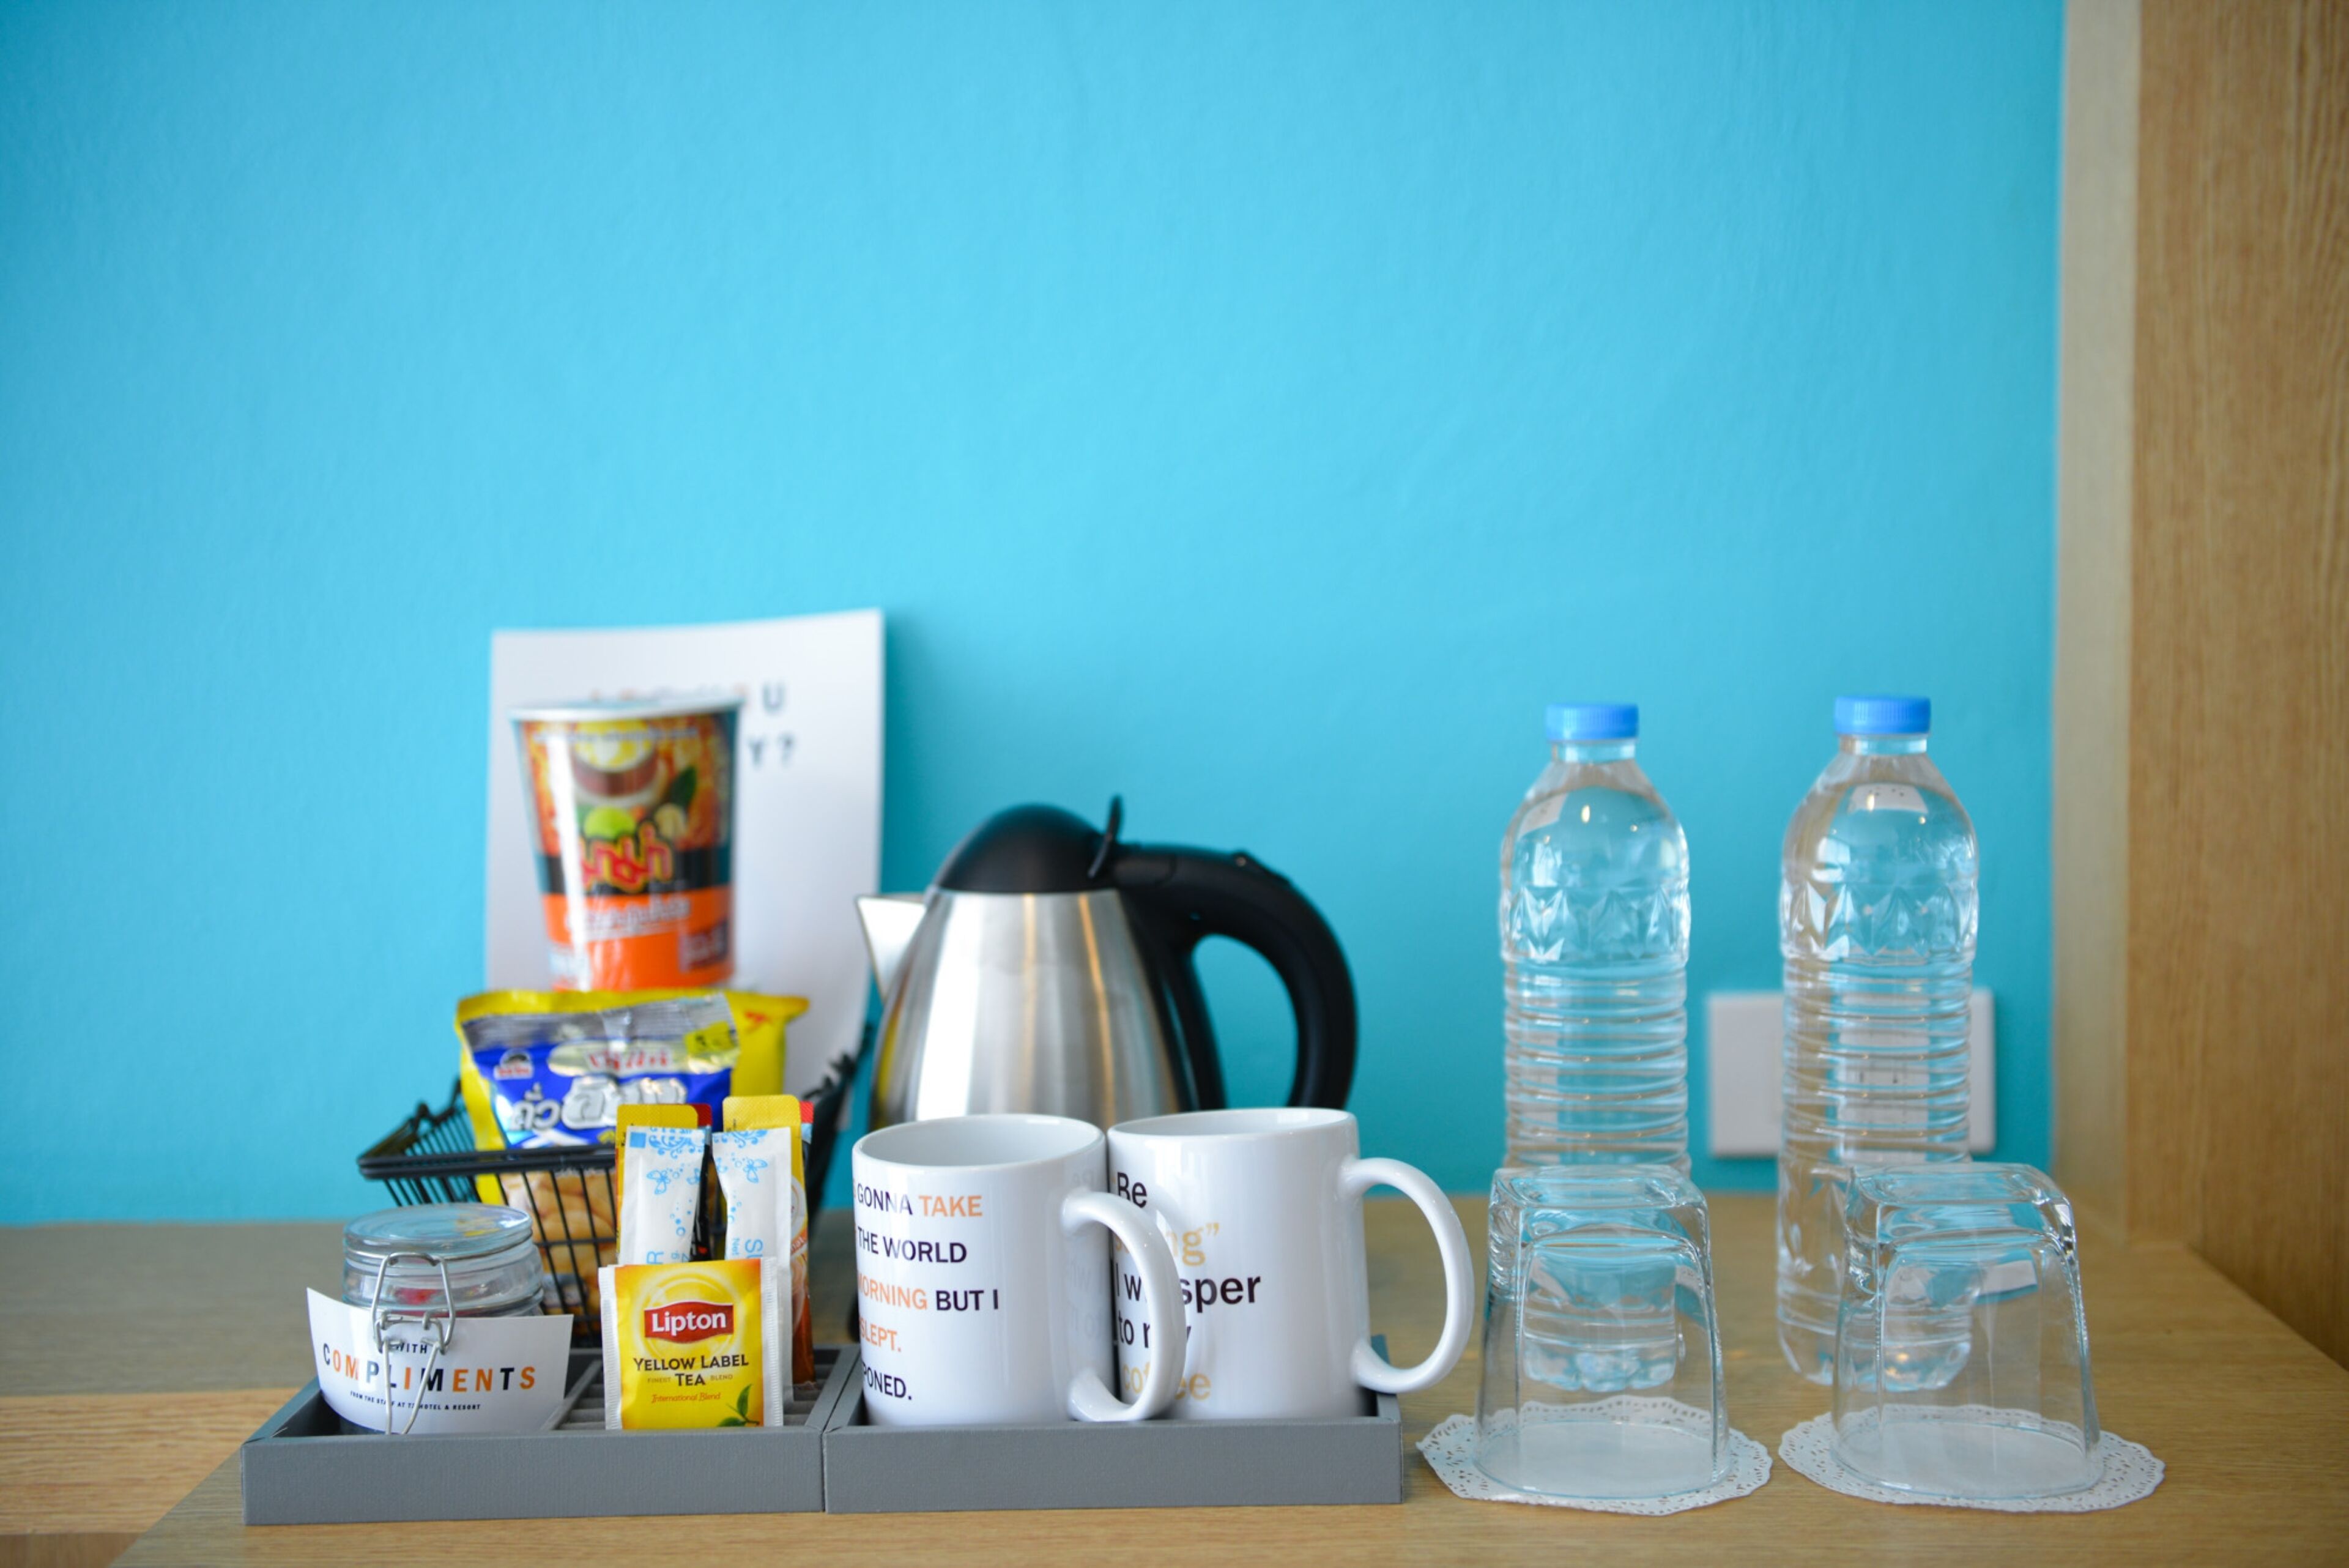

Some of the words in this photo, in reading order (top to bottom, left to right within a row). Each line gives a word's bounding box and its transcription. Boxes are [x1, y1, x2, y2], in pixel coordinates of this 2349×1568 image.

[857, 1183, 913, 1216] GONNA
[918, 1195, 982, 1217] TAKE
[858, 1225, 878, 1254] THE
[883, 1236, 967, 1263] WORLD
[936, 1290, 984, 1311] BUT
[993, 1288, 999, 1310] I
[1124, 1275, 1261, 1313] wsper
[651, 1311, 727, 1336] Lipton
[395, 1341, 428, 1354] WITH
[633, 1356, 696, 1371] YELLOW
[701, 1354, 749, 1369] LABEL
[675, 1373, 706, 1386] TEA
[376, 1398, 395, 1406] STF
[651, 1394, 697, 1403] International
[699, 1392, 721, 1401] Blend
